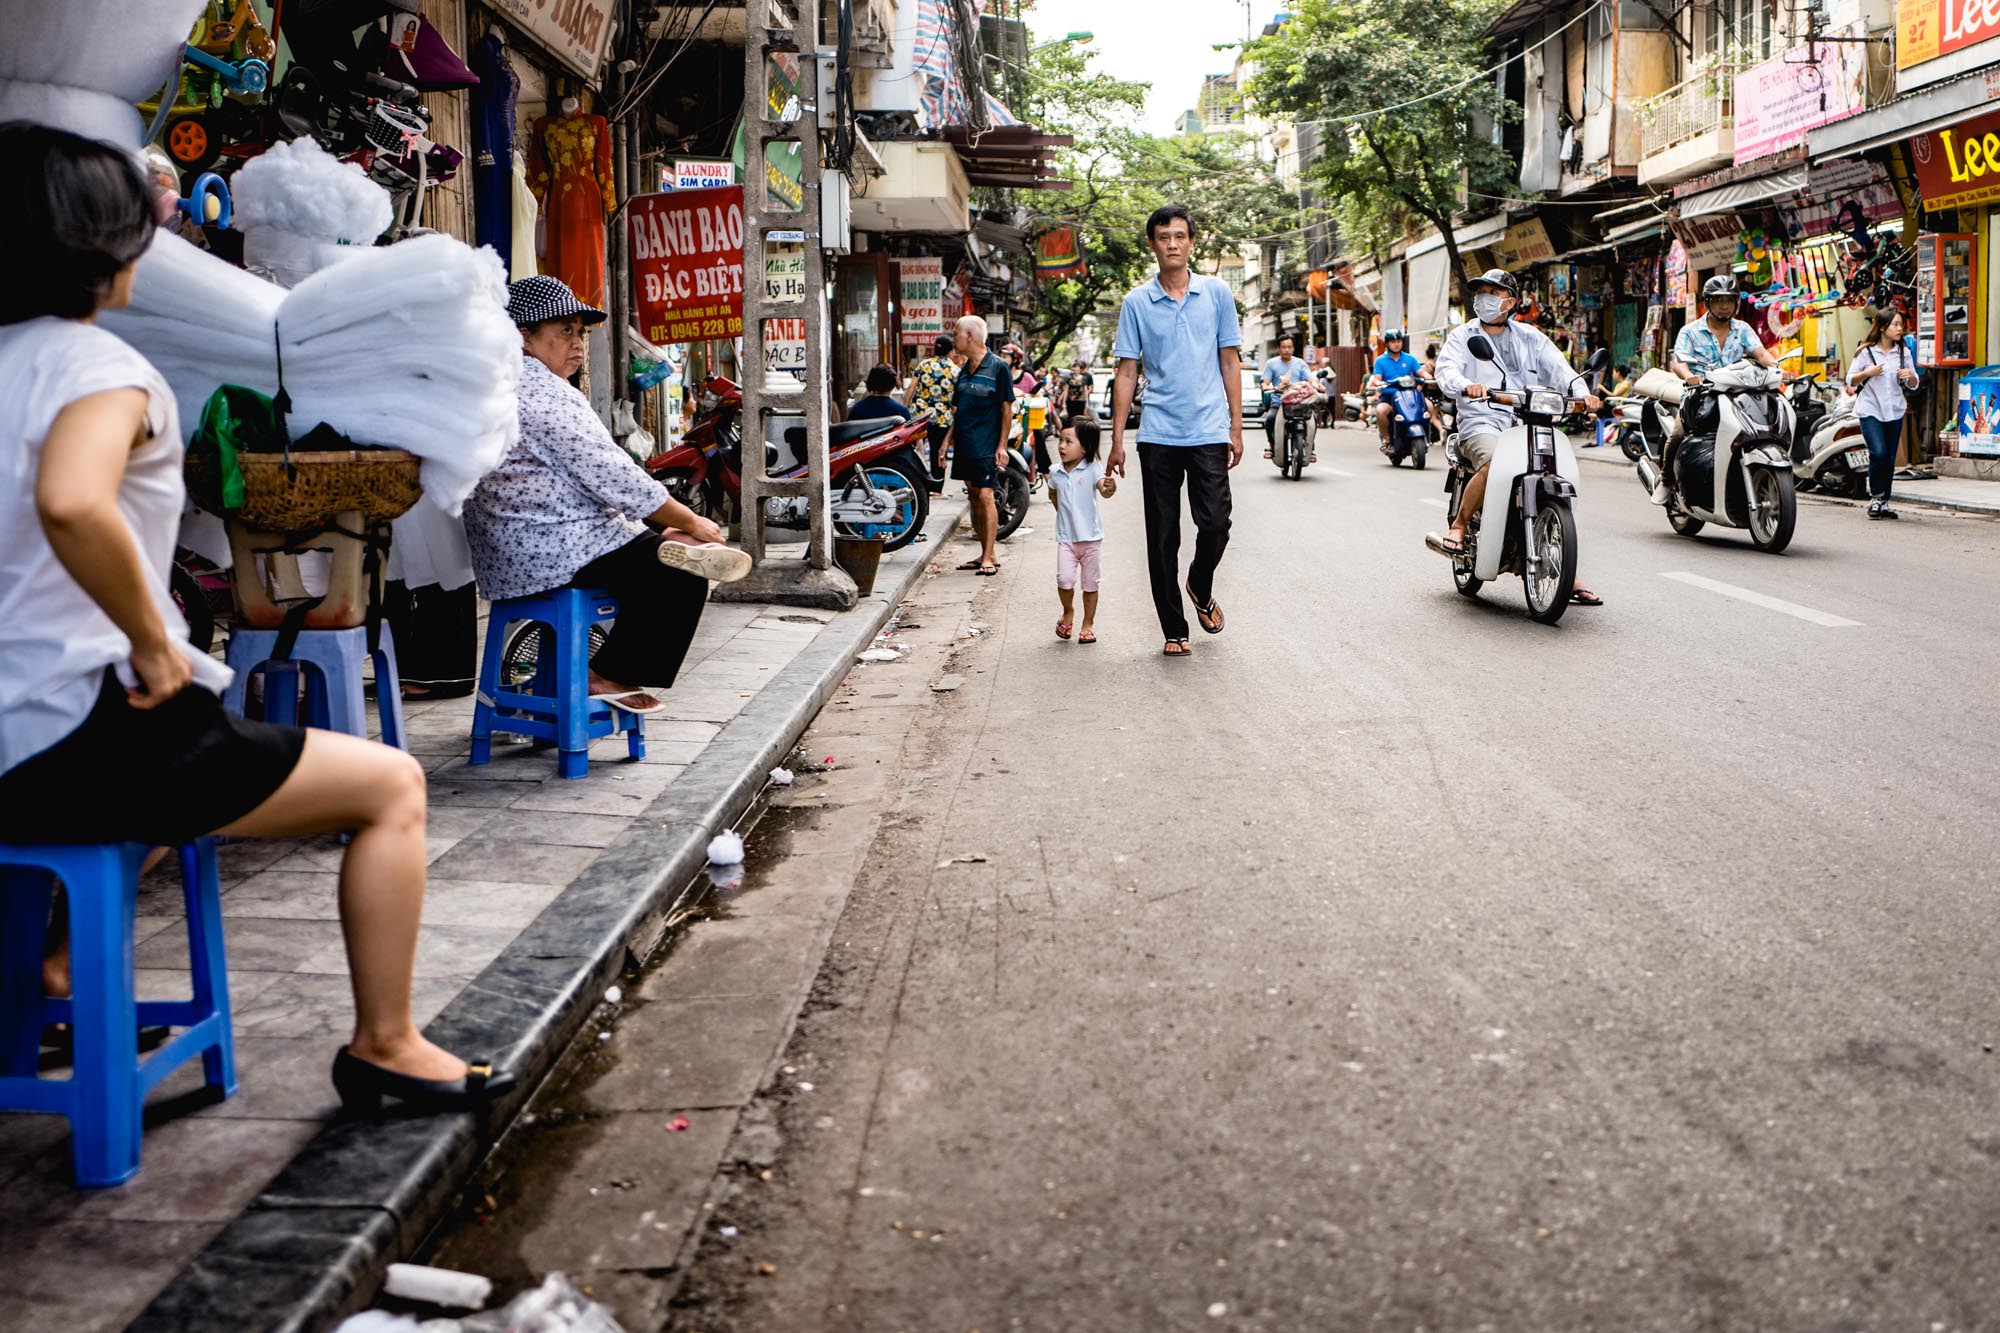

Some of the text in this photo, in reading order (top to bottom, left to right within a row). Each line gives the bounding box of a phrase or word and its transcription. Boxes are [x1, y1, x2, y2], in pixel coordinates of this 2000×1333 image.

[1908, 19, 1927, 44] 27
[1940, 129, 2000, 183] Lee
[677, 163, 730, 177] LAUNDRY
[680, 177, 728, 188] SIM CARD
[632, 200, 744, 260] BÁNH BAO
[645, 257, 743, 309] ĐẶC BIỆT
[665, 308, 682, 321] NHÀ
[682, 306, 704, 319] HÀNG
[720, 304, 732, 315] AN
[651, 325, 668, 342] ĐT:
[671, 320, 700, 340] 0945
[703, 318, 725, 337] 228
